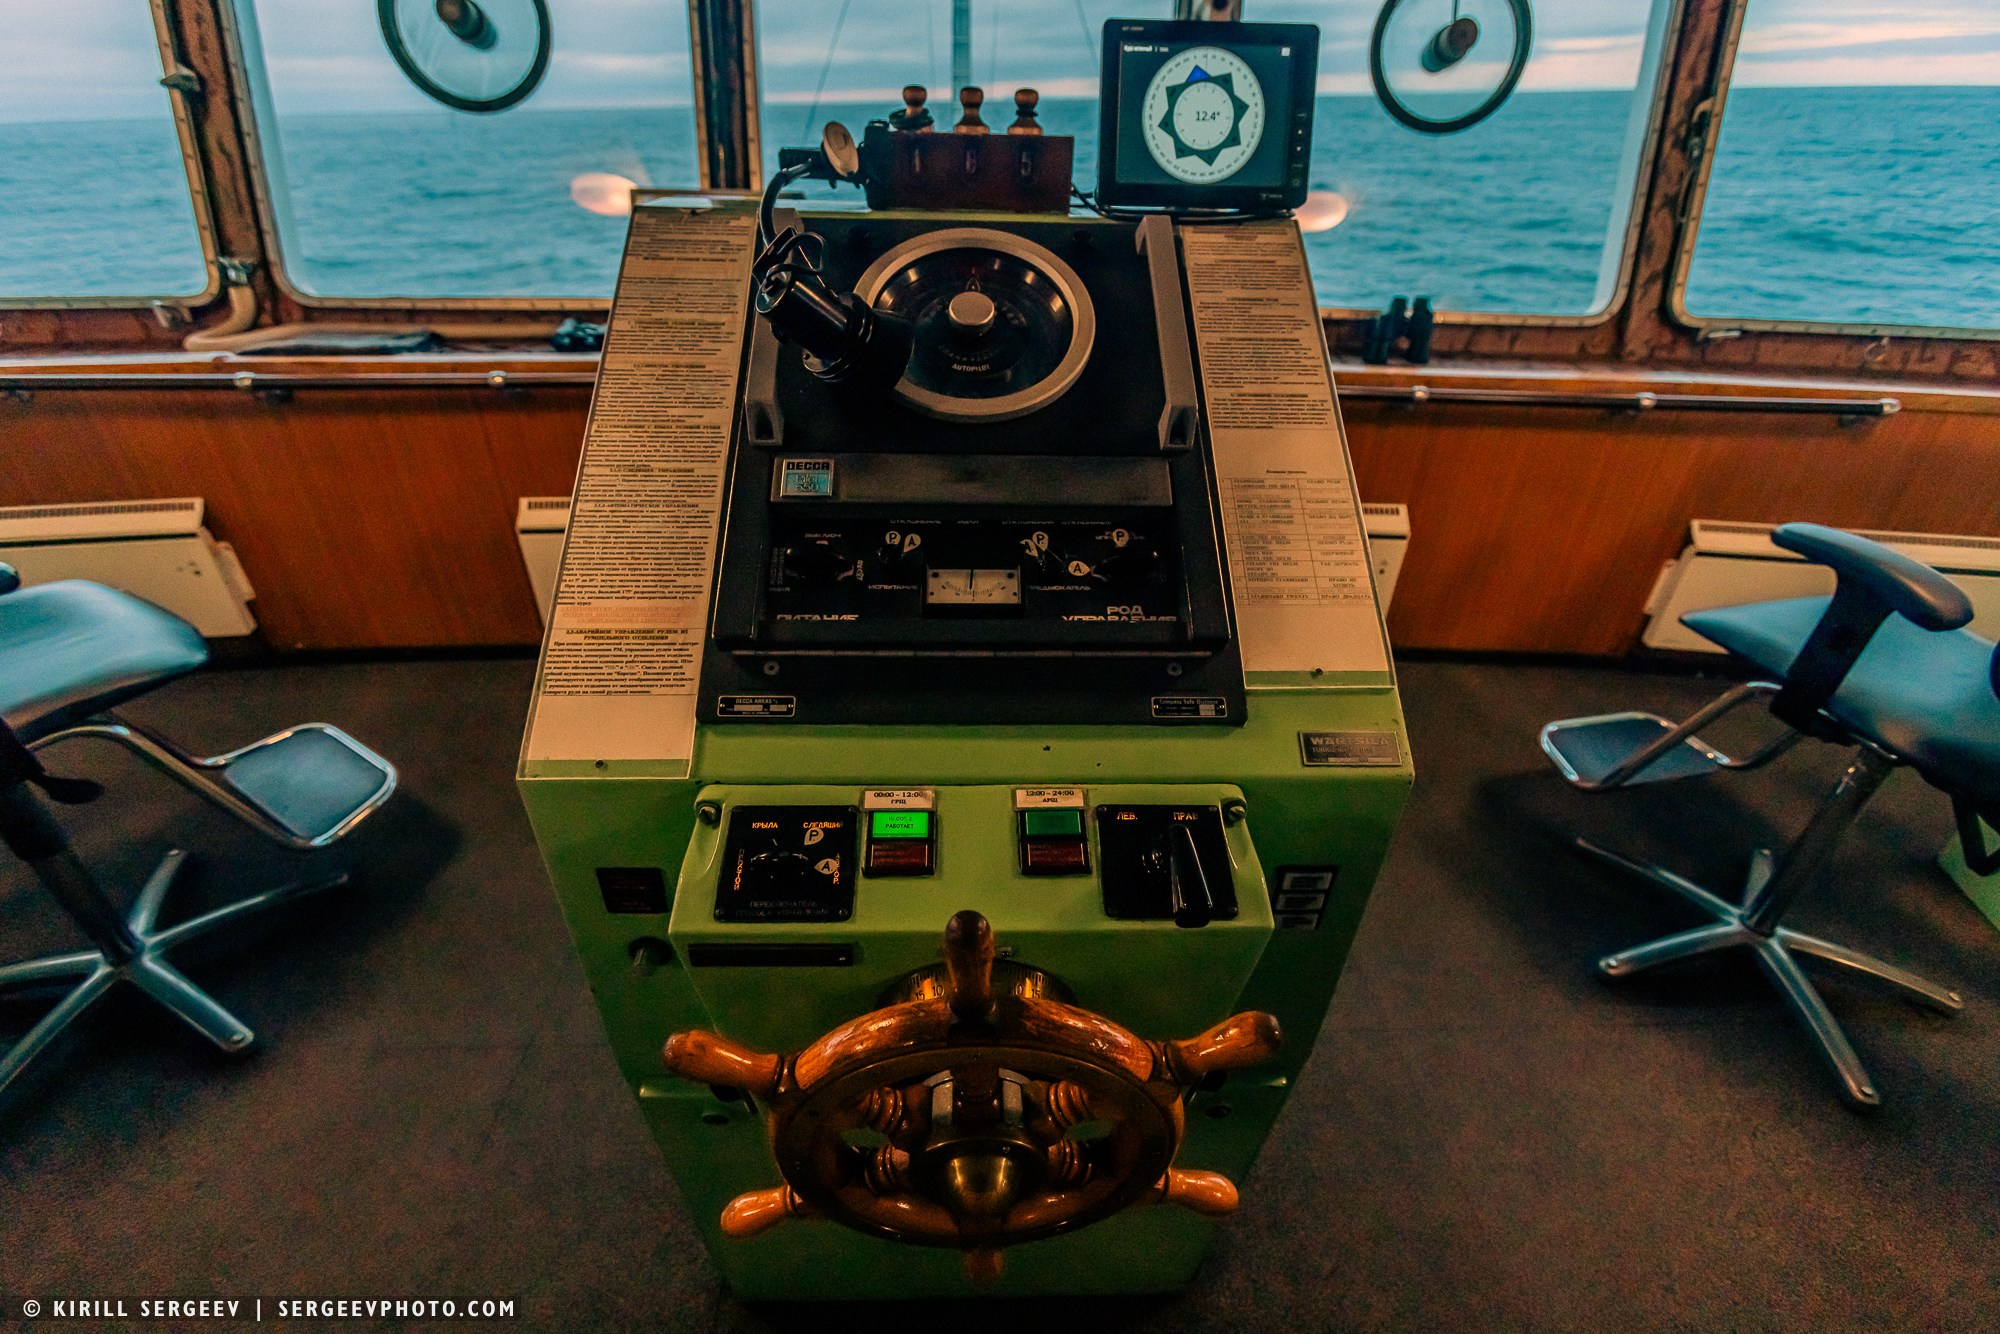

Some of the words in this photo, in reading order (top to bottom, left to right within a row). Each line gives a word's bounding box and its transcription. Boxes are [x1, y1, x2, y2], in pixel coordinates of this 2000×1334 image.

[952, 362, 990, 373] AUTOPILOT
[787, 462, 830, 470] DECCA
[1107, 605, 1144, 615] РОД
[1116, 812, 1138, 820] ЛЕВ.
